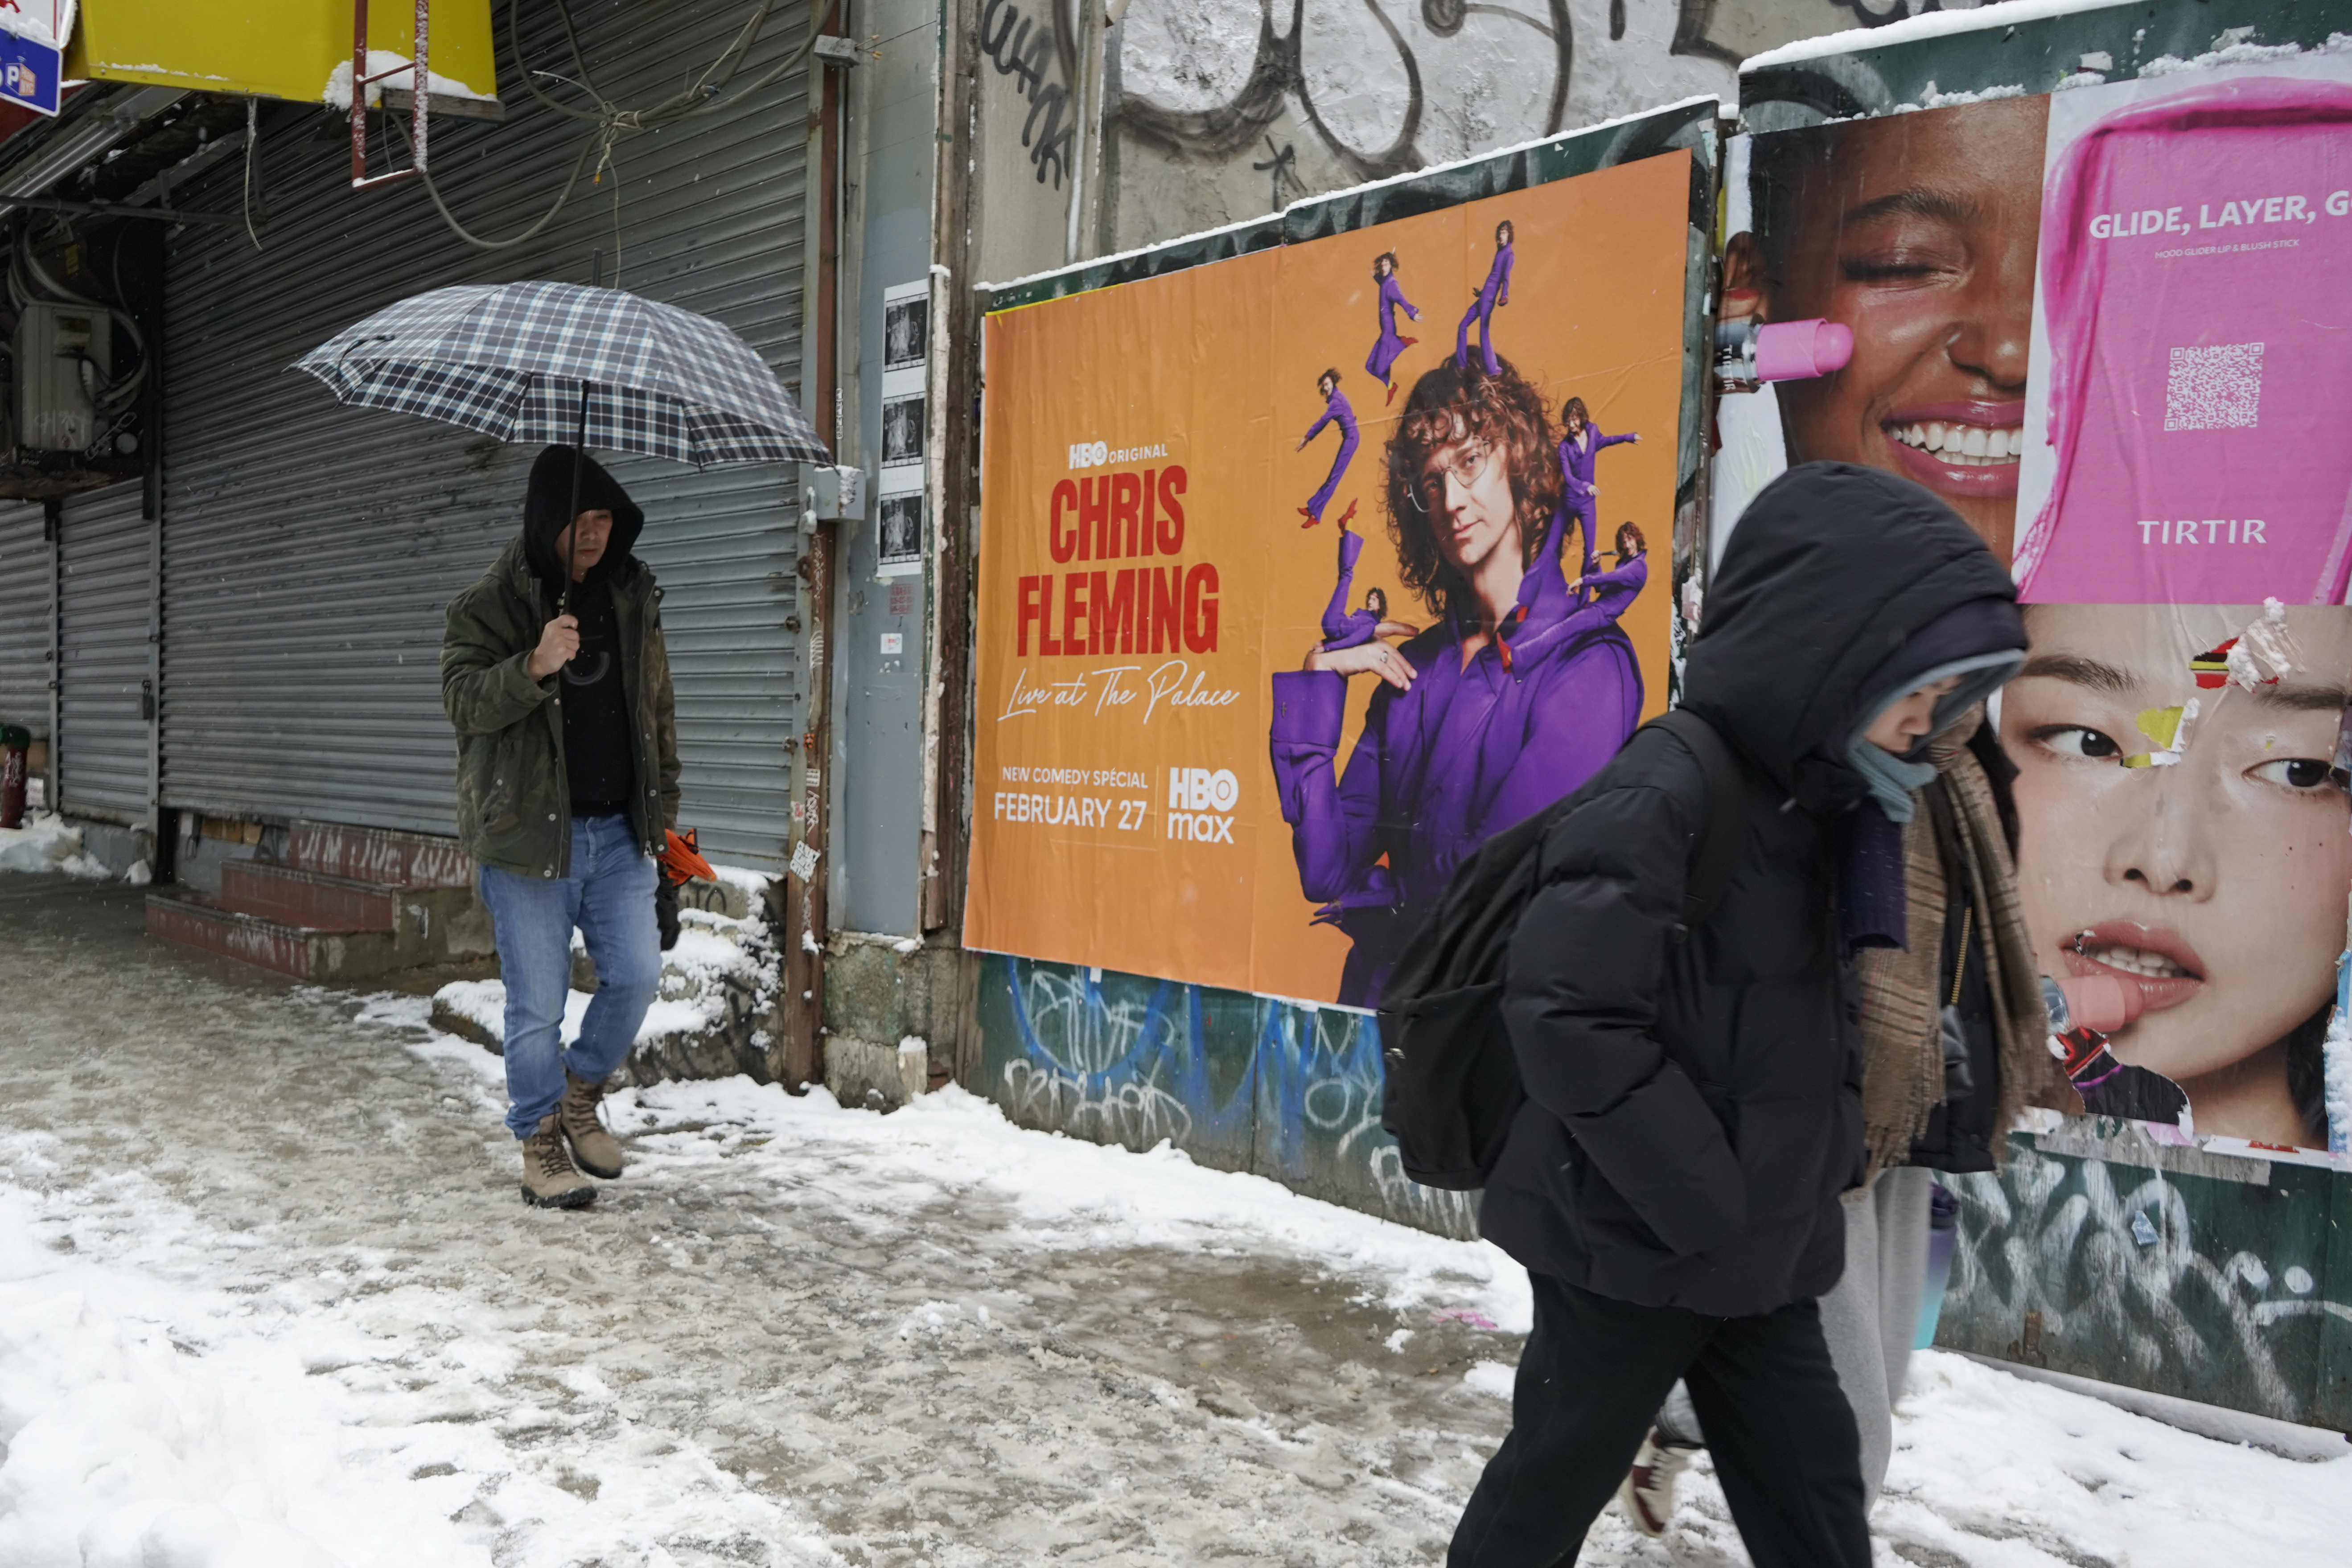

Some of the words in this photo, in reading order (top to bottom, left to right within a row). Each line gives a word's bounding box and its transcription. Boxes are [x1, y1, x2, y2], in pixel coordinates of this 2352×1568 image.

[7, 66, 19, 86] P
[2089, 206, 2191, 238] GLIDE,
[2199, 195, 2316, 228] LAYER,
[2325, 190, 2352, 216] G
[2155, 249, 2183, 259] MOOD
[2185, 246, 2216, 256] GLIDER
[2217, 245, 2230, 253] LIP
[2241, 241, 2270, 251] BLUSH
[2273, 238, 2300, 248] STICK
[1069, 440, 1108, 469] HBO
[1108, 443, 1168, 464] ORIGINAL
[1050, 465, 1187, 564] CHRIS
[2137, 519, 2267, 544] TIRTIR
[1017, 562, 1220, 657] FLEMING
[997, 668, 1052, 722] Live
[1051, 673, 1087, 706] at
[1091, 666, 1142, 717] The
[1143, 659, 1240, 725] Palace
[1002, 766, 1031, 782] NEW
[1032, 767, 1091, 786] COMEDY
[1093, 769, 1148, 788] SPECIAL
[1168, 767, 1239, 812] HBO
[994, 792, 1113, 828] FEBRUARY
[1117, 800, 1148, 831] 27
[1167, 811, 1235, 845] max
